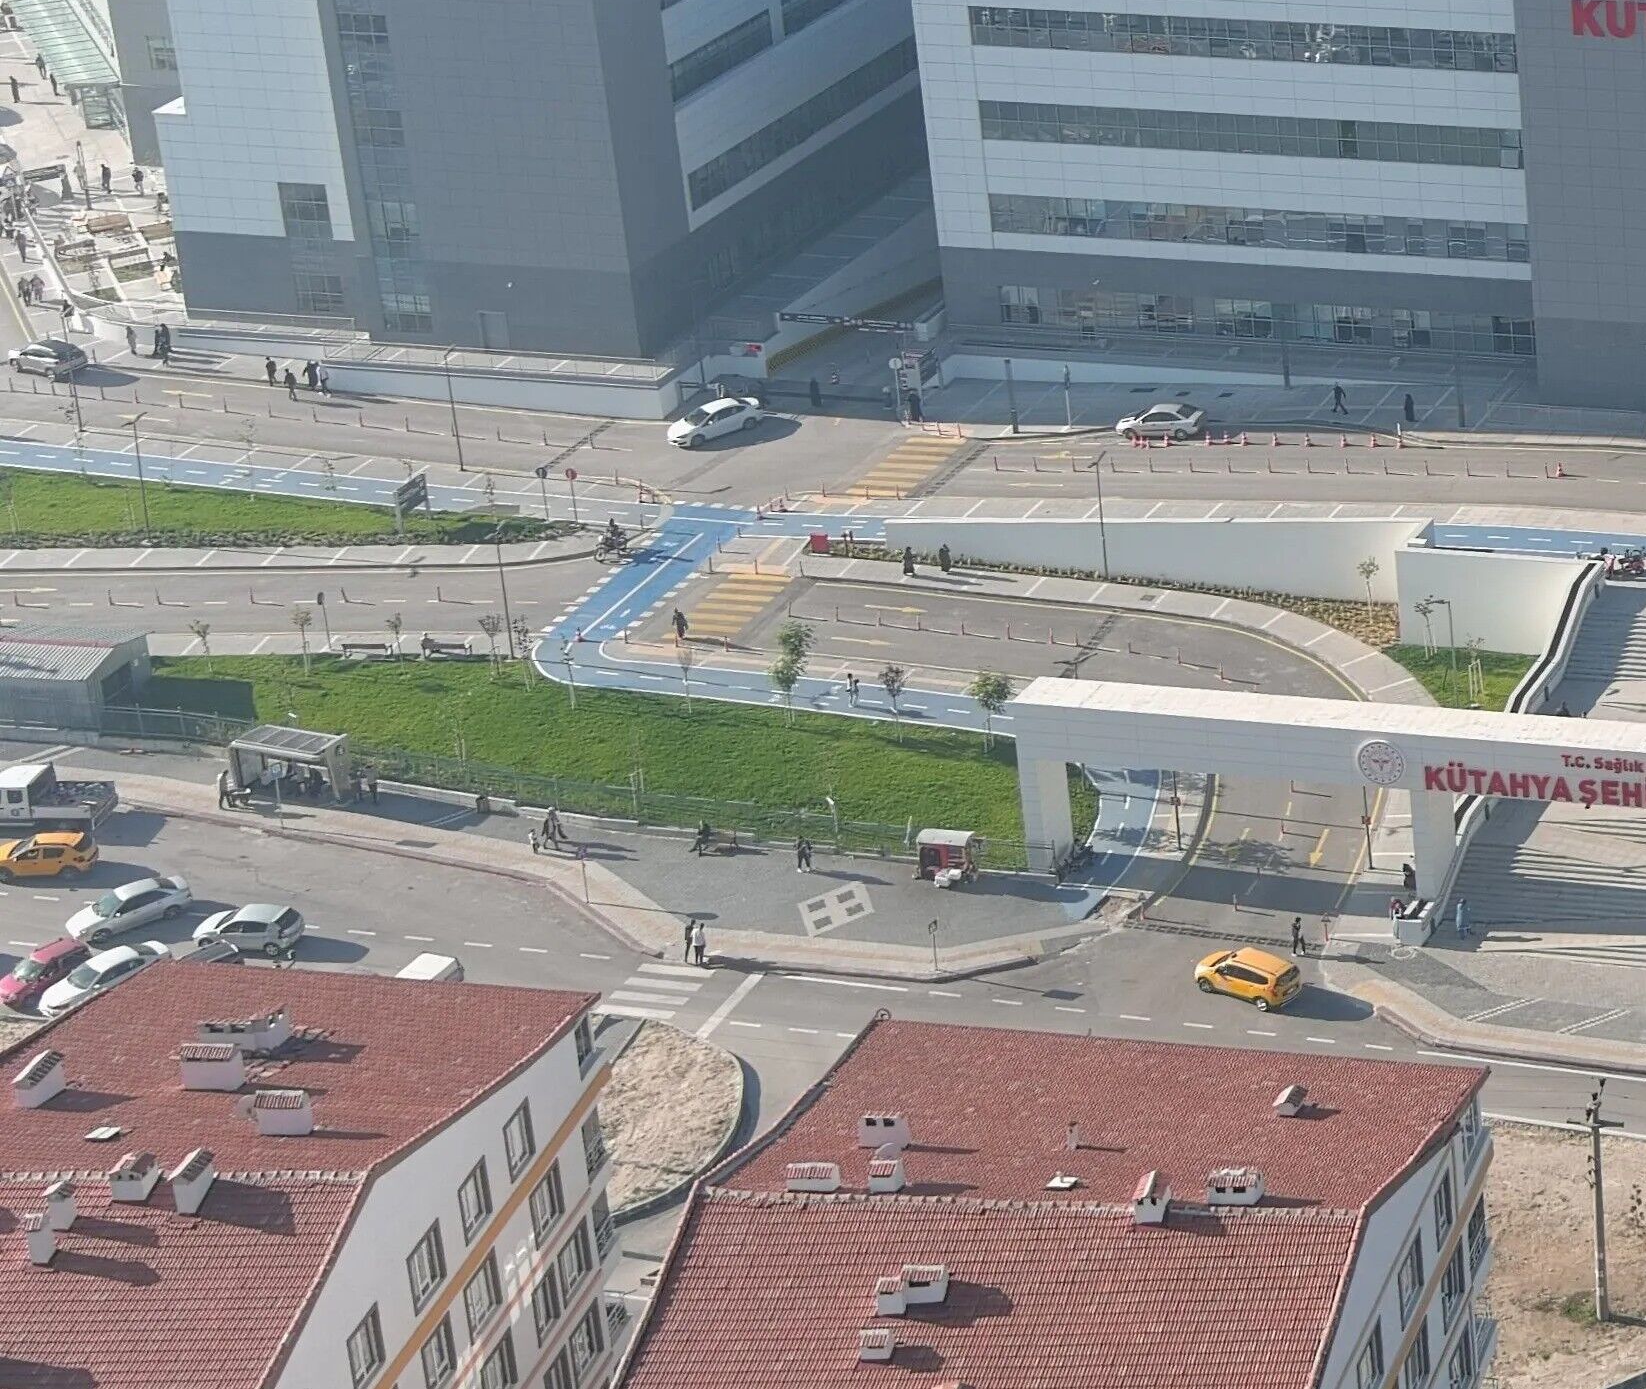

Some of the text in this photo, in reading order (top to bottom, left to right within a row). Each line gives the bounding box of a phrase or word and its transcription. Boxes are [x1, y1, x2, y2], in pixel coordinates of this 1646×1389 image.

[1561, 754, 1591, 769] T.C.
[1594, 756, 1644, 775] Sağlık
[1424, 762, 1573, 802] KÜTAHYA
